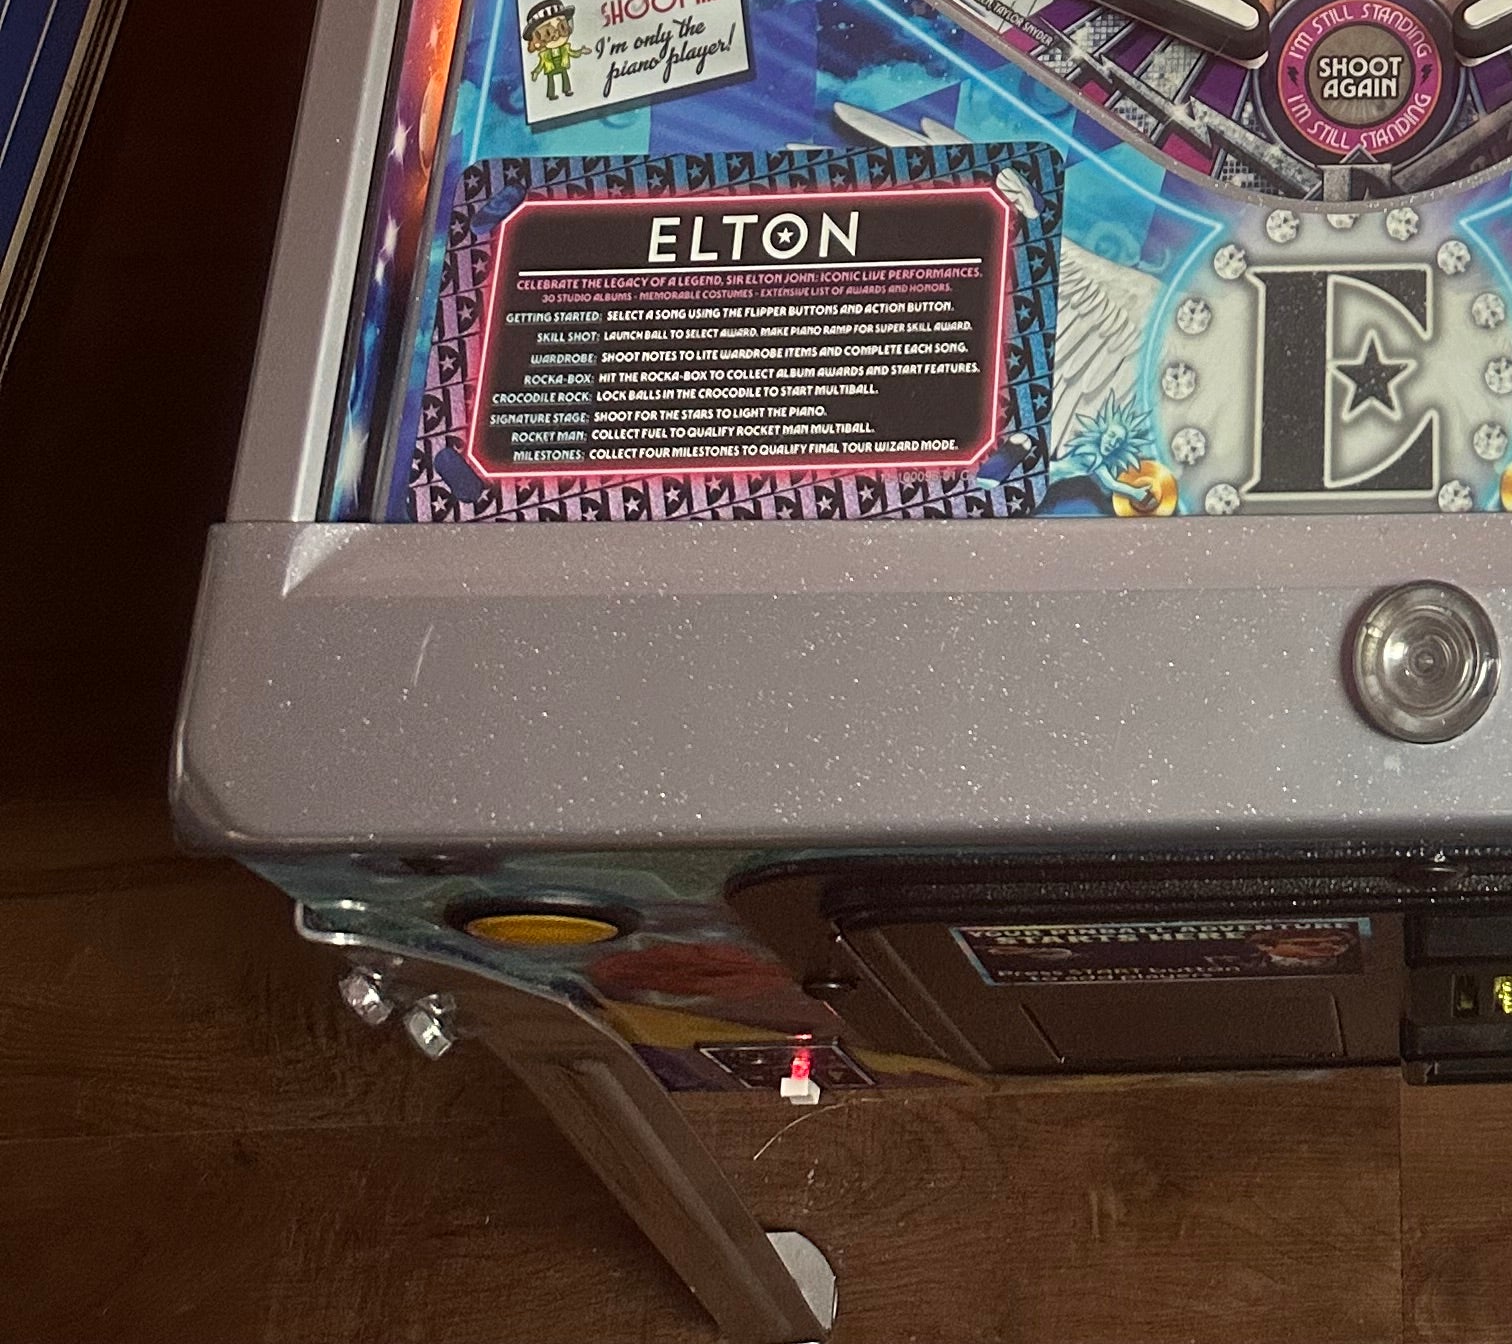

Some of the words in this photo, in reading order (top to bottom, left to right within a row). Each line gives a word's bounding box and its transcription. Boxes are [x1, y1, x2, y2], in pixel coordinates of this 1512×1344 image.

[595, 35, 629, 60] I'm
[633, 23, 673, 61] only
[672, 15, 707, 39] the
[1288, 30, 1314, 60] I'M
[1311, 4, 1355, 35] STILL
[1360, 2, 1433, 59] STANDING
[603, 56, 661, 98] piano
[662, 21, 737, 84] player!
[1318, 56, 1403, 78] SHOOT
[1322, 77, 1398, 99] AGAIN
[1287, 94, 1312, 124] I'M
[1306, 120, 1351, 150] STILL
[1359, 92, 1432, 149] STANDING
[647, 210, 860, 264] ELTON
[516, 279, 580, 291] CELEBRATE
[580, 278, 602, 290] THE
[603, 277, 648, 290] LEGACY
[649, 277, 667, 288] OF
[668, 276, 676, 288] A
[677, 275, 724, 288] LEGEND,
[726, 274, 743, 286] SIR
[745, 273, 783, 285] ELTON
[820, 271, 861, 283] ICONIC
[862, 270, 887, 281] LIVE
[888, 267, 983, 280] PERFORMANCES.
[505, 312, 552, 324] GETTING
[553, 311, 602, 323] STARTED:
[607, 310, 645, 322] SELECT
[645, 310, 654, 321] A
[654, 309, 686, 321] SONG
[688, 307, 720, 319] USING
[722, 306, 743, 318] THE
[744, 305, 787, 318] FLIPPER
[788, 304, 838, 316] BUTTONS
[839, 303, 863, 314] AND
[864, 302, 906, 314] ACTION
[907, 300, 955, 313] BUTTON.
[1242, 262, 1440, 499] E
